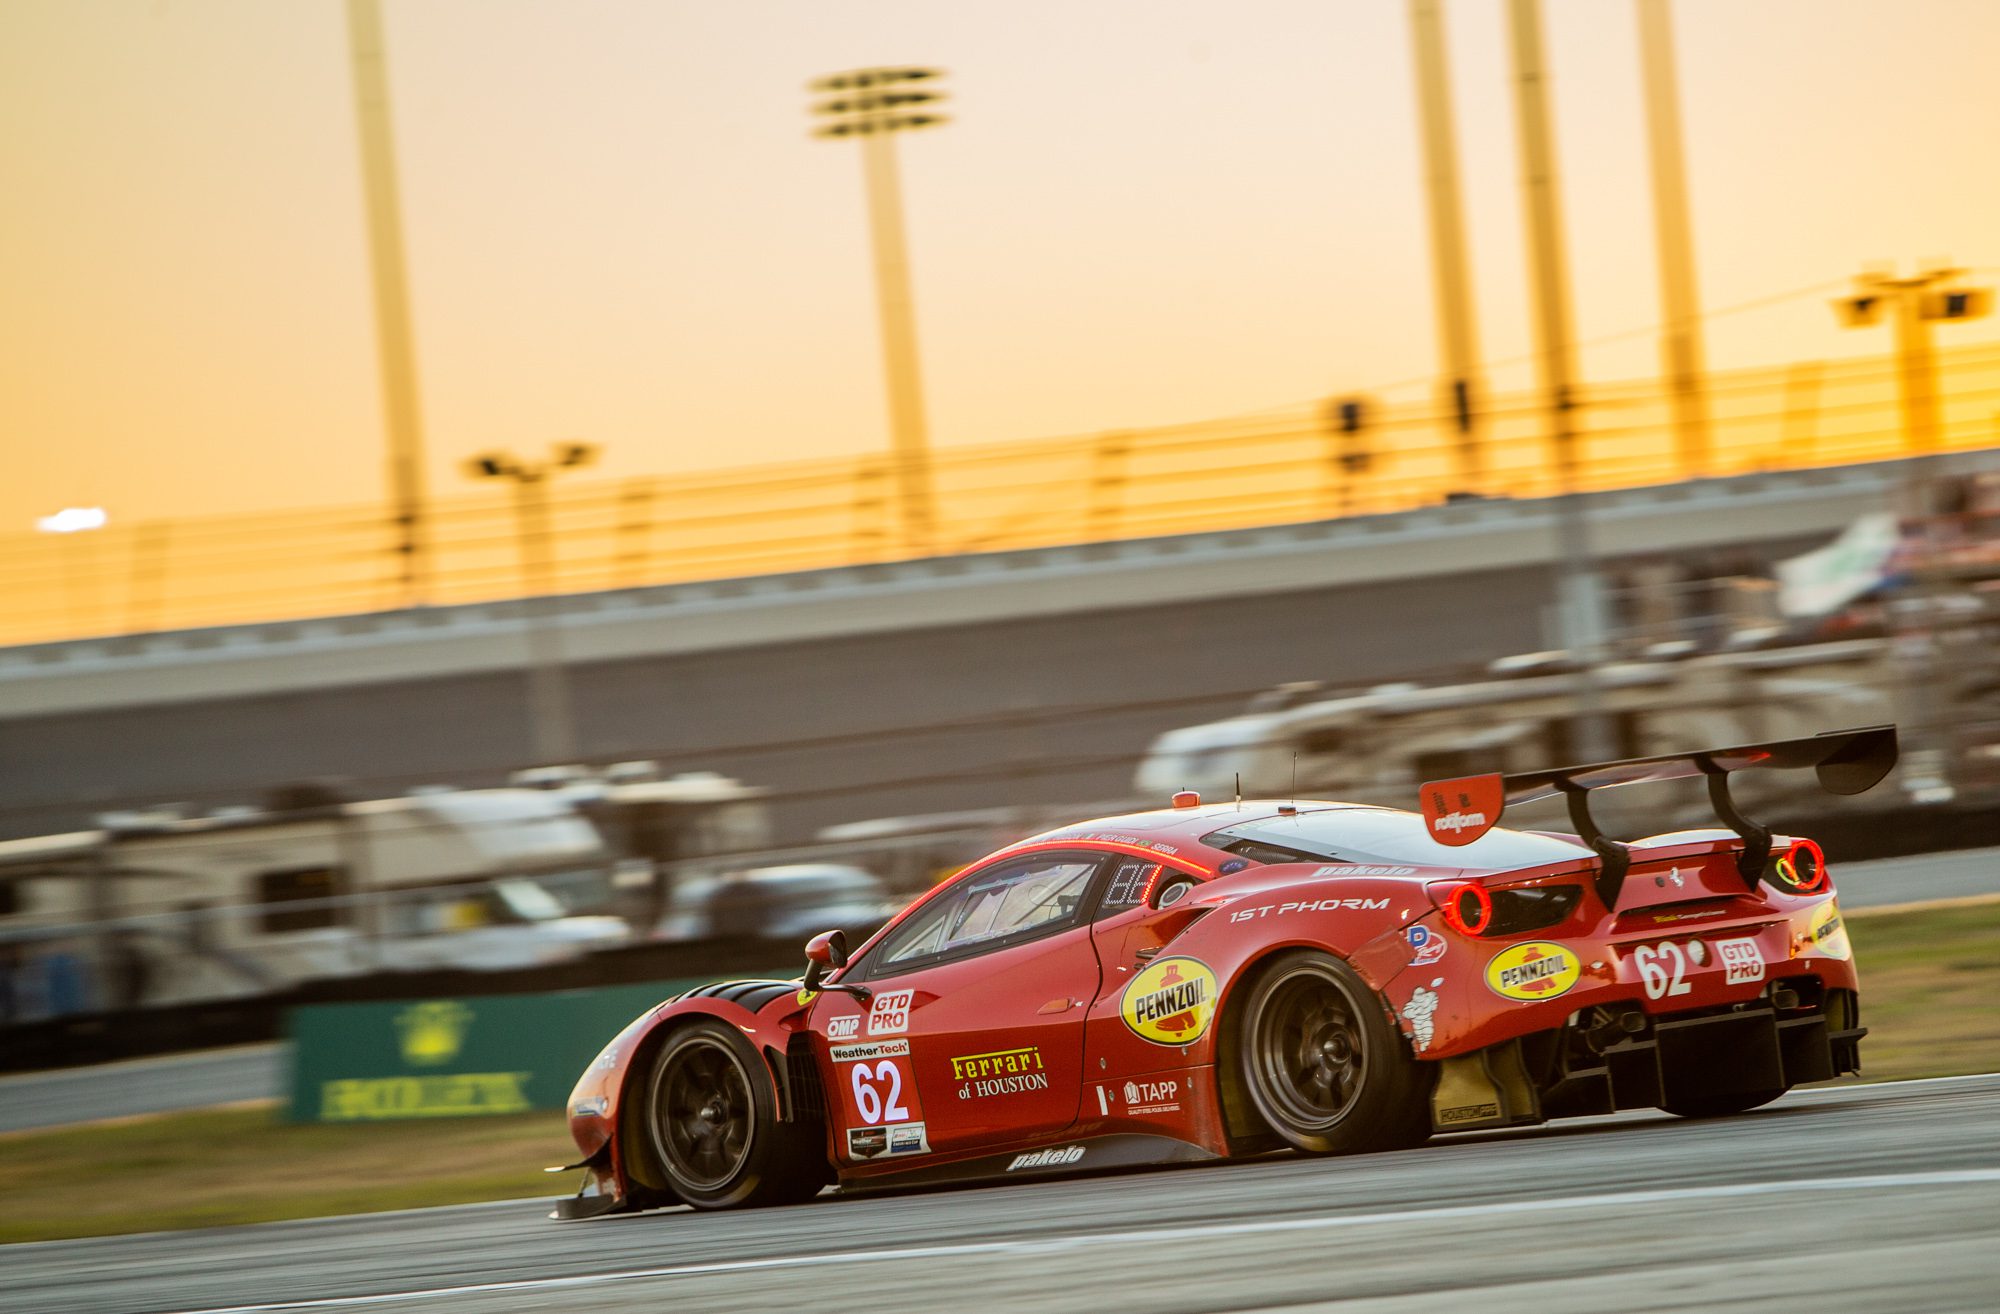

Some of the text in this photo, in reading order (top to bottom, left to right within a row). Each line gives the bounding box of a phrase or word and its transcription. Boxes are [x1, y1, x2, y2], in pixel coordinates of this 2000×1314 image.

[1311, 865, 1417, 878] pakelo
[1230, 898, 1391, 924] 1ST PHORM
[1722, 942, 1756, 961] GTD
[1500, 954, 1568, 988] PENNZOIL
[1634, 941, 1692, 1000] 62
[1728, 960, 1762, 980] PRO
[874, 994, 909, 1012] GTD
[1135, 978, 1206, 1025] PENNZOIL
[827, 1018, 860, 1037] OMP
[871, 1011, 904, 1030] PRO
[832, 1042, 908, 1060] WeatherTech
[951, 1046, 1044, 1080] Ferrari
[851, 1059, 909, 1124] 62
[958, 1072, 1049, 1100] of HOUSTON
[1139, 1080, 1178, 1102] TAPP
[1006, 1145, 1087, 1172] pakelo
